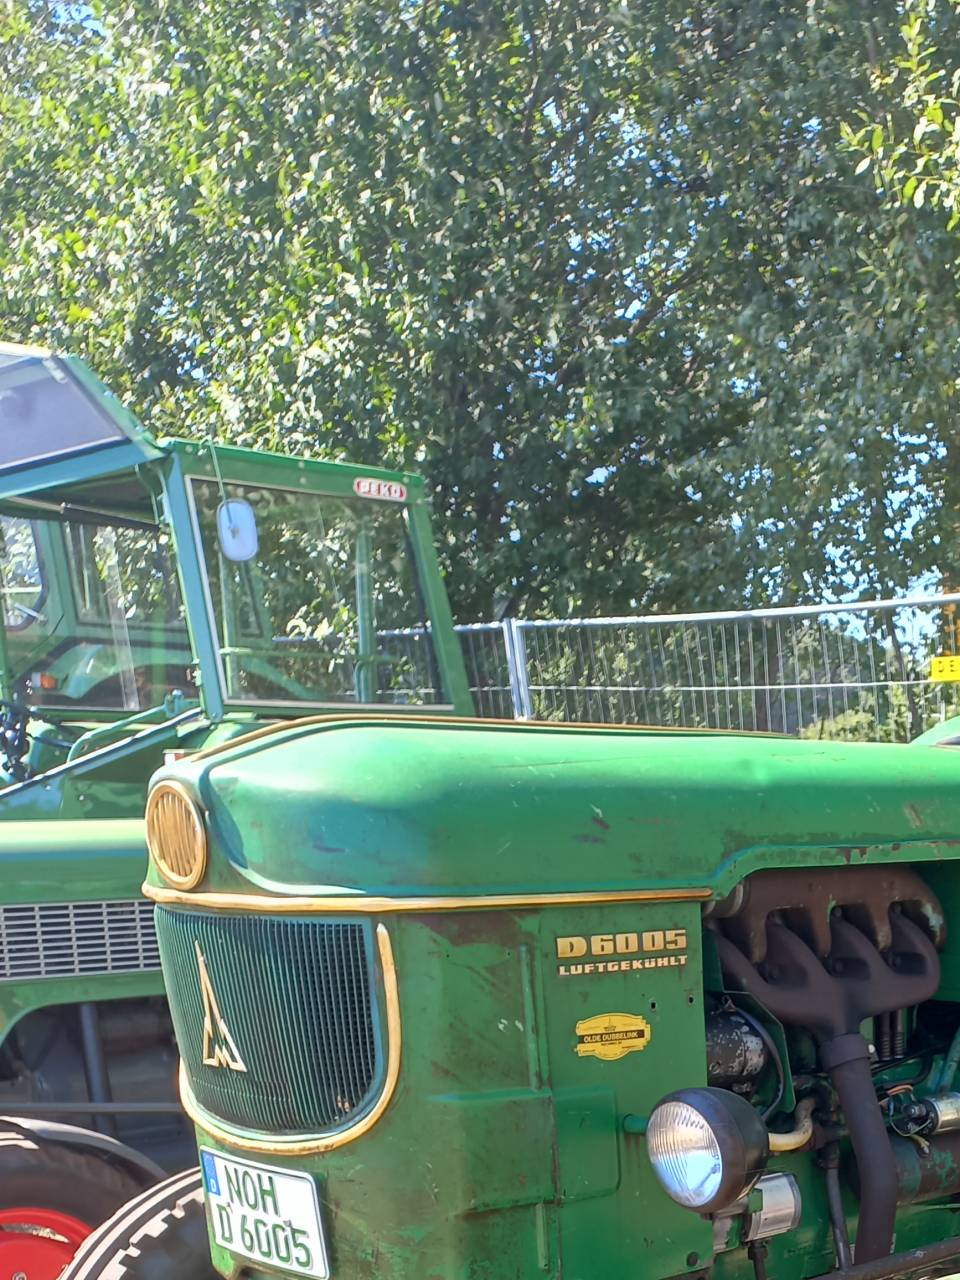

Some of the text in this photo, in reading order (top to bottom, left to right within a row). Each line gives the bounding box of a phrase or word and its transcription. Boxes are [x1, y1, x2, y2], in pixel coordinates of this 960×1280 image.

[558, 955, 688, 976] LUFTGEKÜHLT
[583, 1035, 601, 1043] OLDE
[224, 1164, 280, 1217] NOH
[216, 1203, 314, 1270] D 6005
